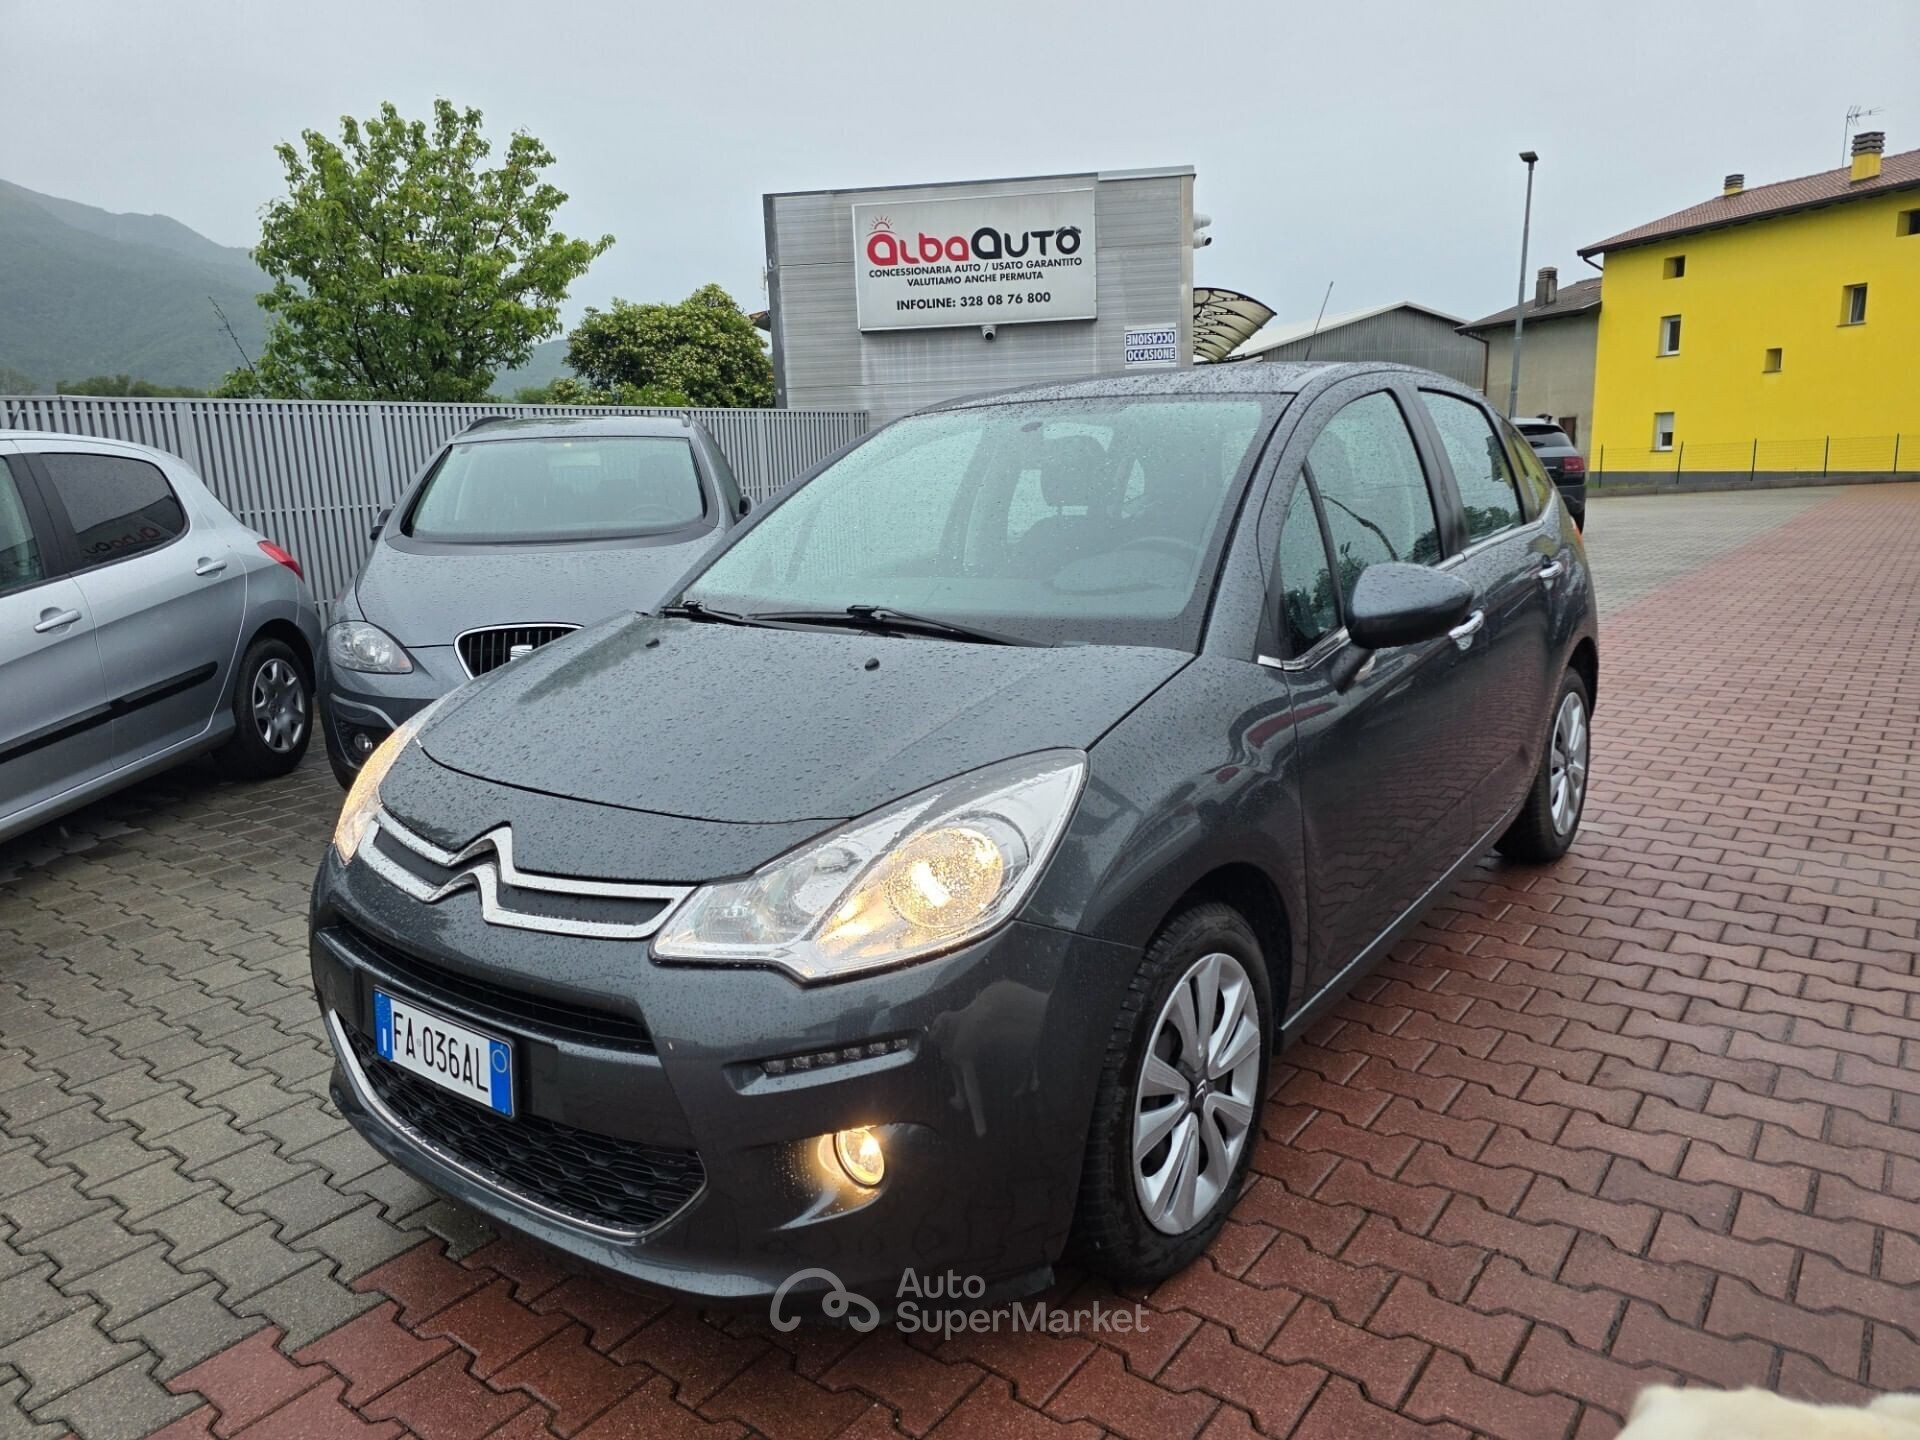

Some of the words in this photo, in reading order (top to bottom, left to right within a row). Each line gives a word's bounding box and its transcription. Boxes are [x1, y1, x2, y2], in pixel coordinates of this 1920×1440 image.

[868, 265, 952, 279] CONCESSIONARIA
[954, 263, 981, 273] AUTO
[991, 260, 1024, 271] USATO
[1025, 257, 1083, 269] GARANTITO
[906, 275, 962, 287] VALUTIAMO
[964, 273, 997, 284] ANCHE
[999, 270, 1044, 281] PERMUTA
[896, 297, 956, 311] INFOLINE:
[959, 295, 984, 307] 328
[987, 294, 1004, 306] 08
[1007, 293, 1024, 305] 76
[1027, 291, 1052, 304] 800
[1127, 348, 1175, 361] OCCASIONE
